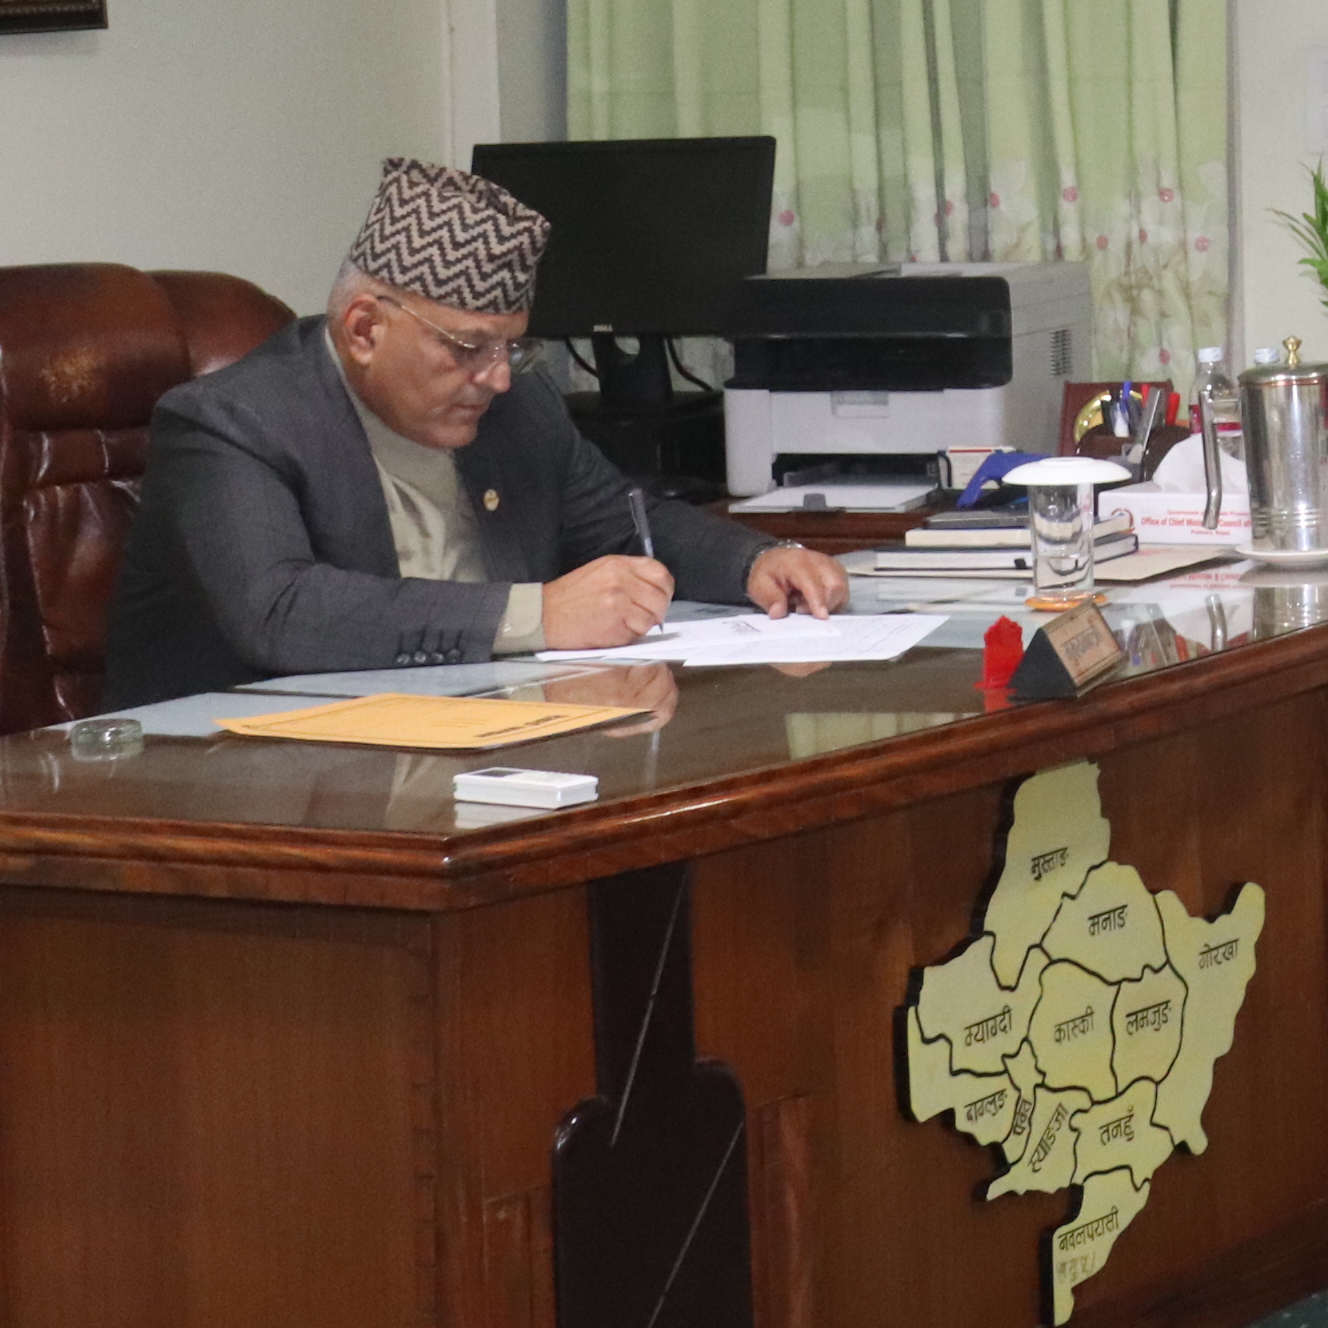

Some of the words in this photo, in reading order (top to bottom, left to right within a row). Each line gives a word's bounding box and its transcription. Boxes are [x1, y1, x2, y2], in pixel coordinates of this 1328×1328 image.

[1141, 517, 1160, 526] Office
[1168, 517, 1186, 526] Chief
[1031, 847, 1070, 882] मुस्ताङ
[1088, 904, 1129, 936] मनाङ
[1199, 938, 1239, 969] गोरखा
[965, 1005, 1014, 1047] म्याग्दी
[1054, 1005, 1095, 1044] कास्की
[1125, 1000, 1172, 1036] लमजुङ
[1099, 1104, 1135, 1145] तनहुँ
[1058, 1205, 1119, 1252] नवलपरासी
